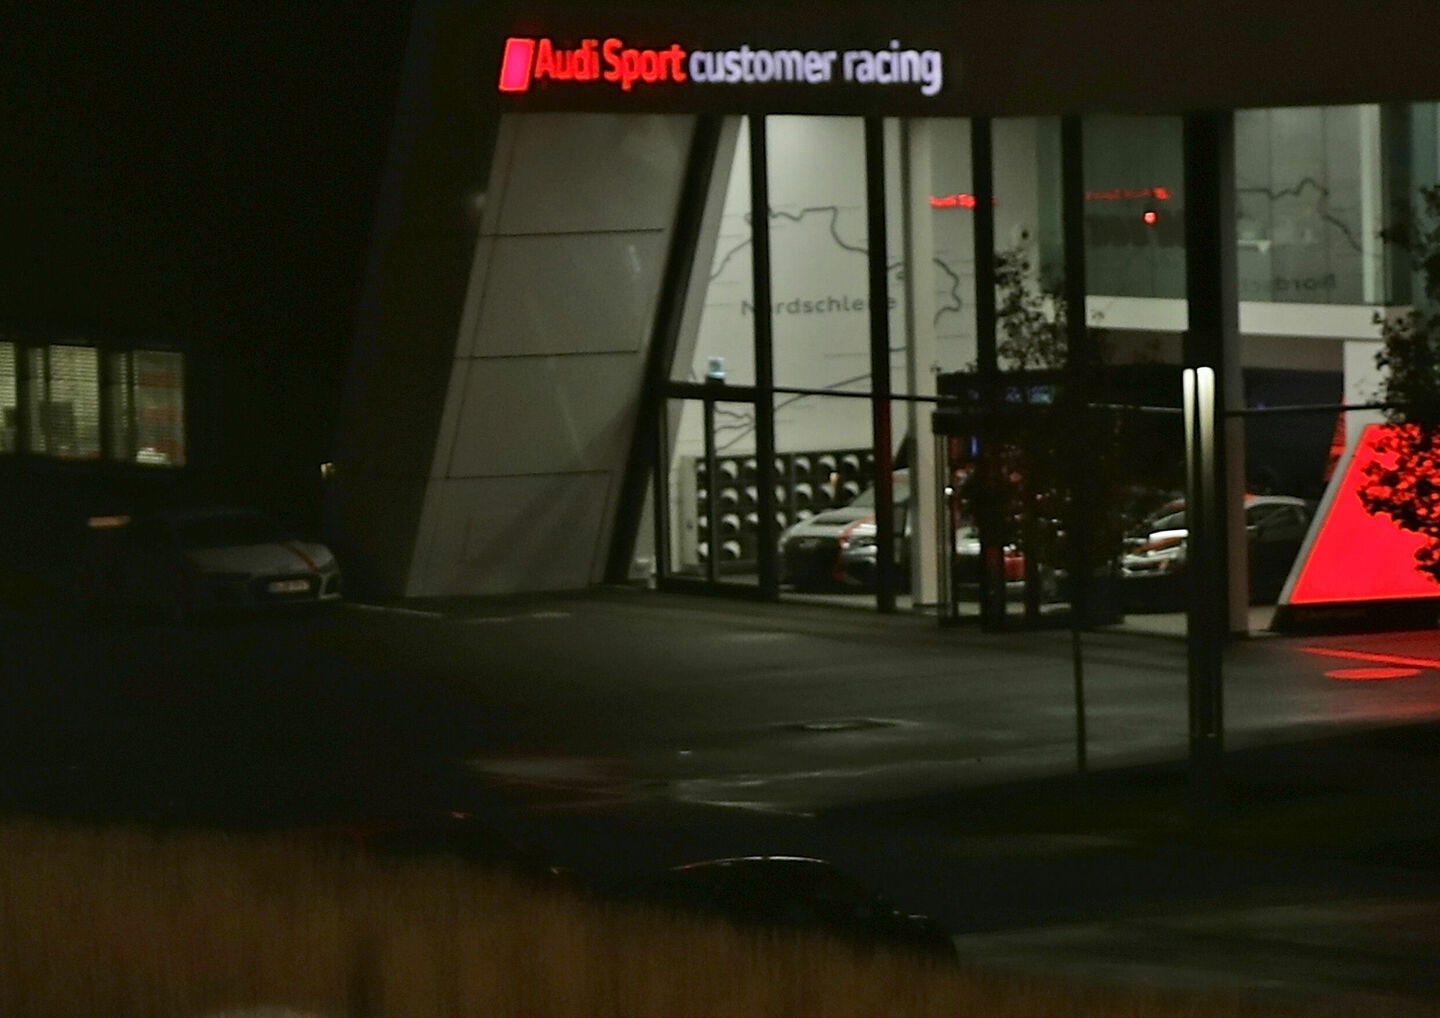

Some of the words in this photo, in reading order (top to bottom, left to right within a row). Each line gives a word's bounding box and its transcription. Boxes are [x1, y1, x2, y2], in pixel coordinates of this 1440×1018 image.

[534, 39, 599, 81] Audi
[603, 38, 687, 91] Sport
[689, 45, 837, 83] customer
[843, 39, 943, 96] racing
